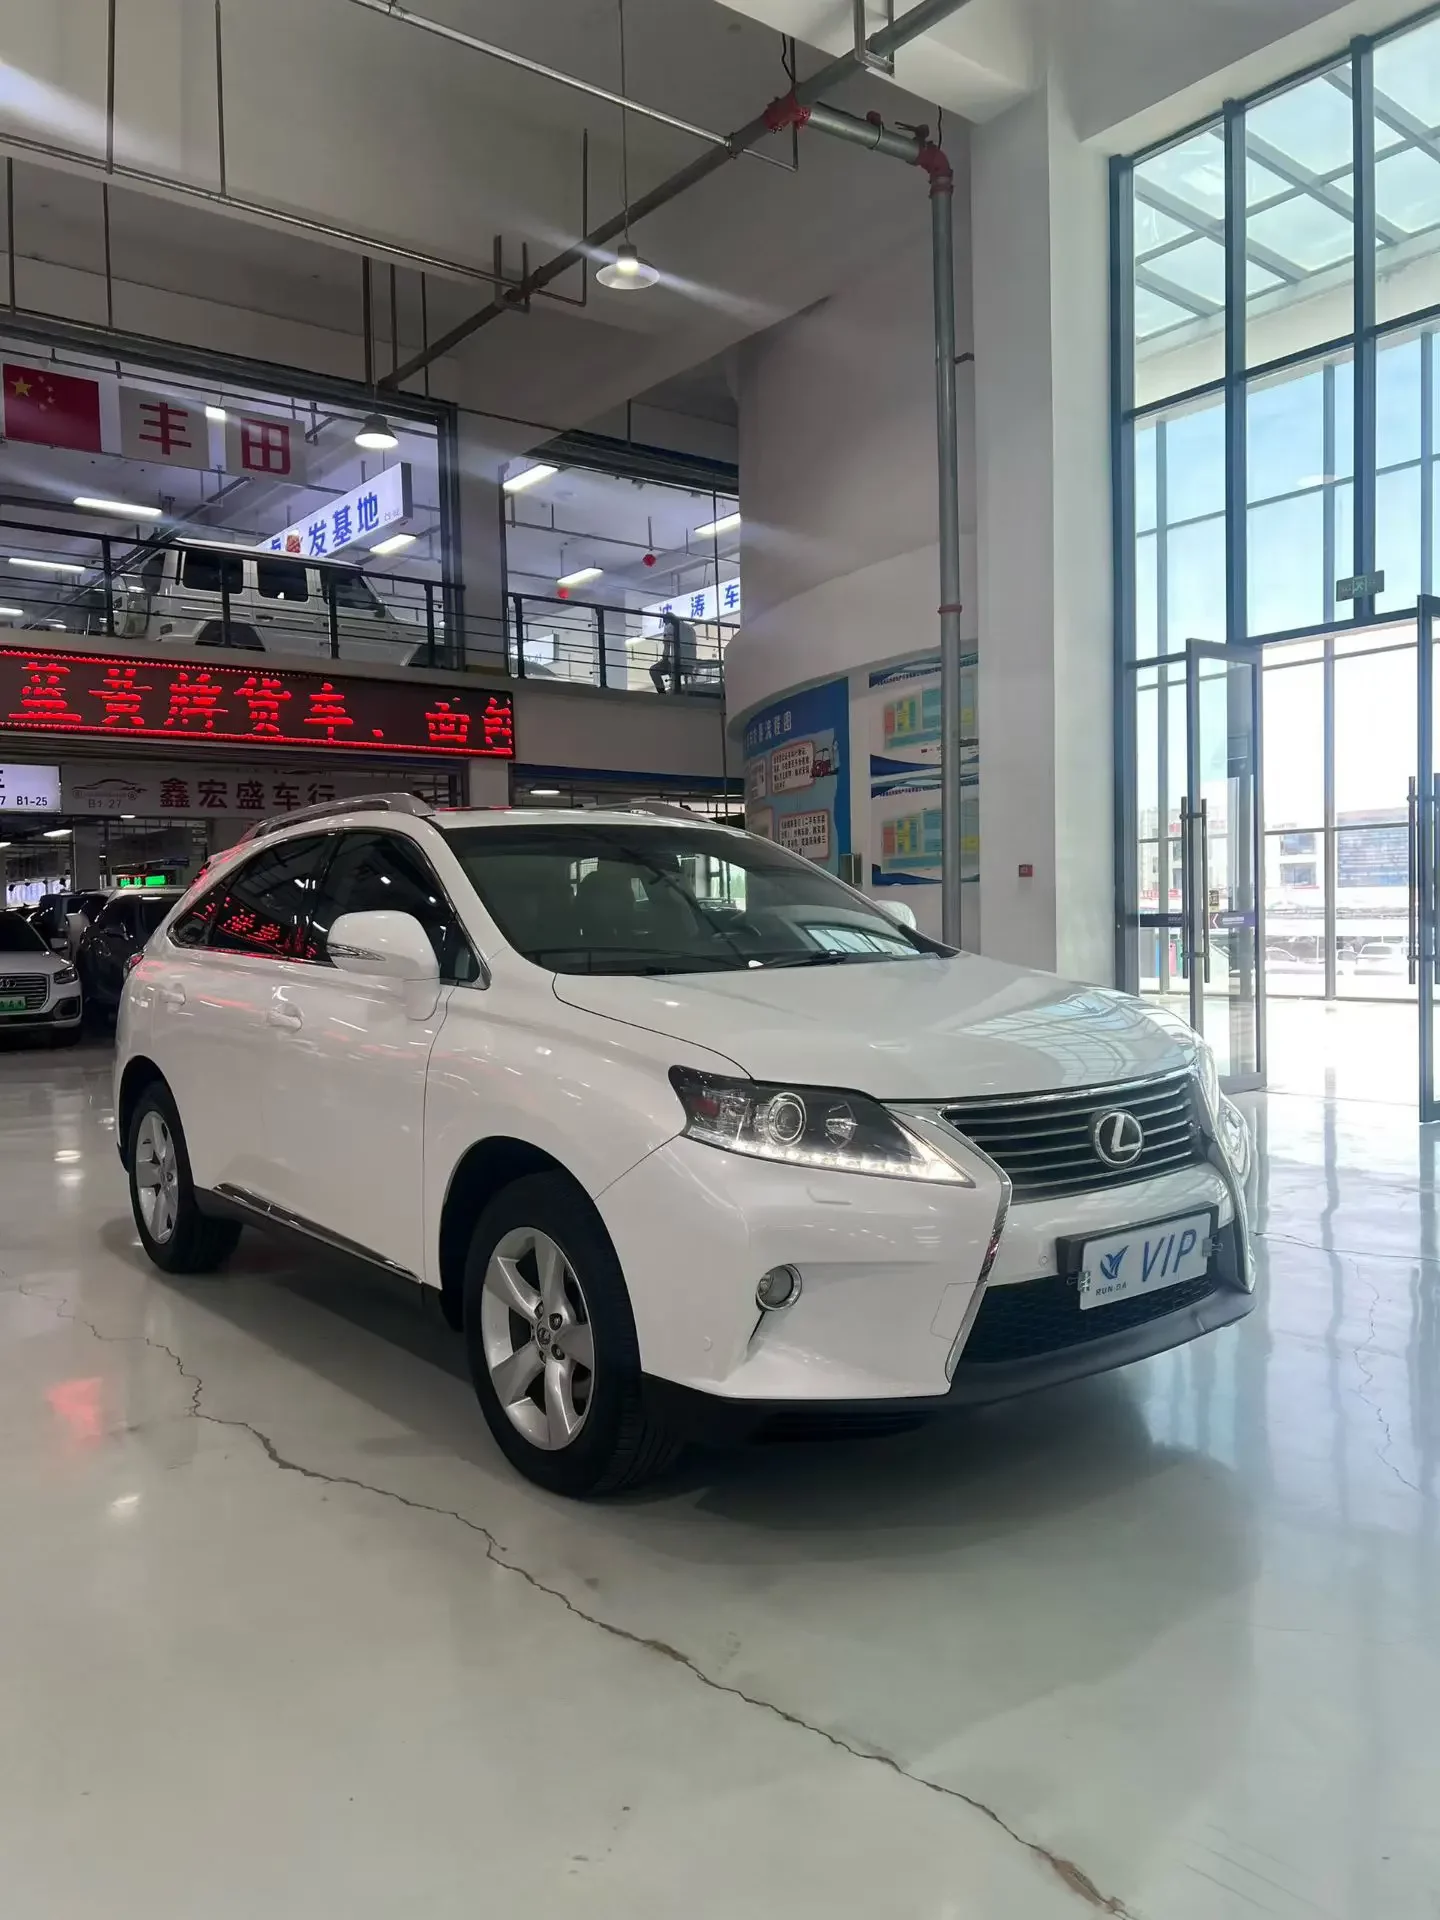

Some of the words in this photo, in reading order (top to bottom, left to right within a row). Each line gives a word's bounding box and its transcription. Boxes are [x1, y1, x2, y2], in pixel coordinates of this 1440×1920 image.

[16, 796, 48, 806] B1-25
[88, 798, 121, 809] B127
[159, 777, 336, 811] 鑫宏盛车行
[1142, 1229, 1197, 1282] VIP
